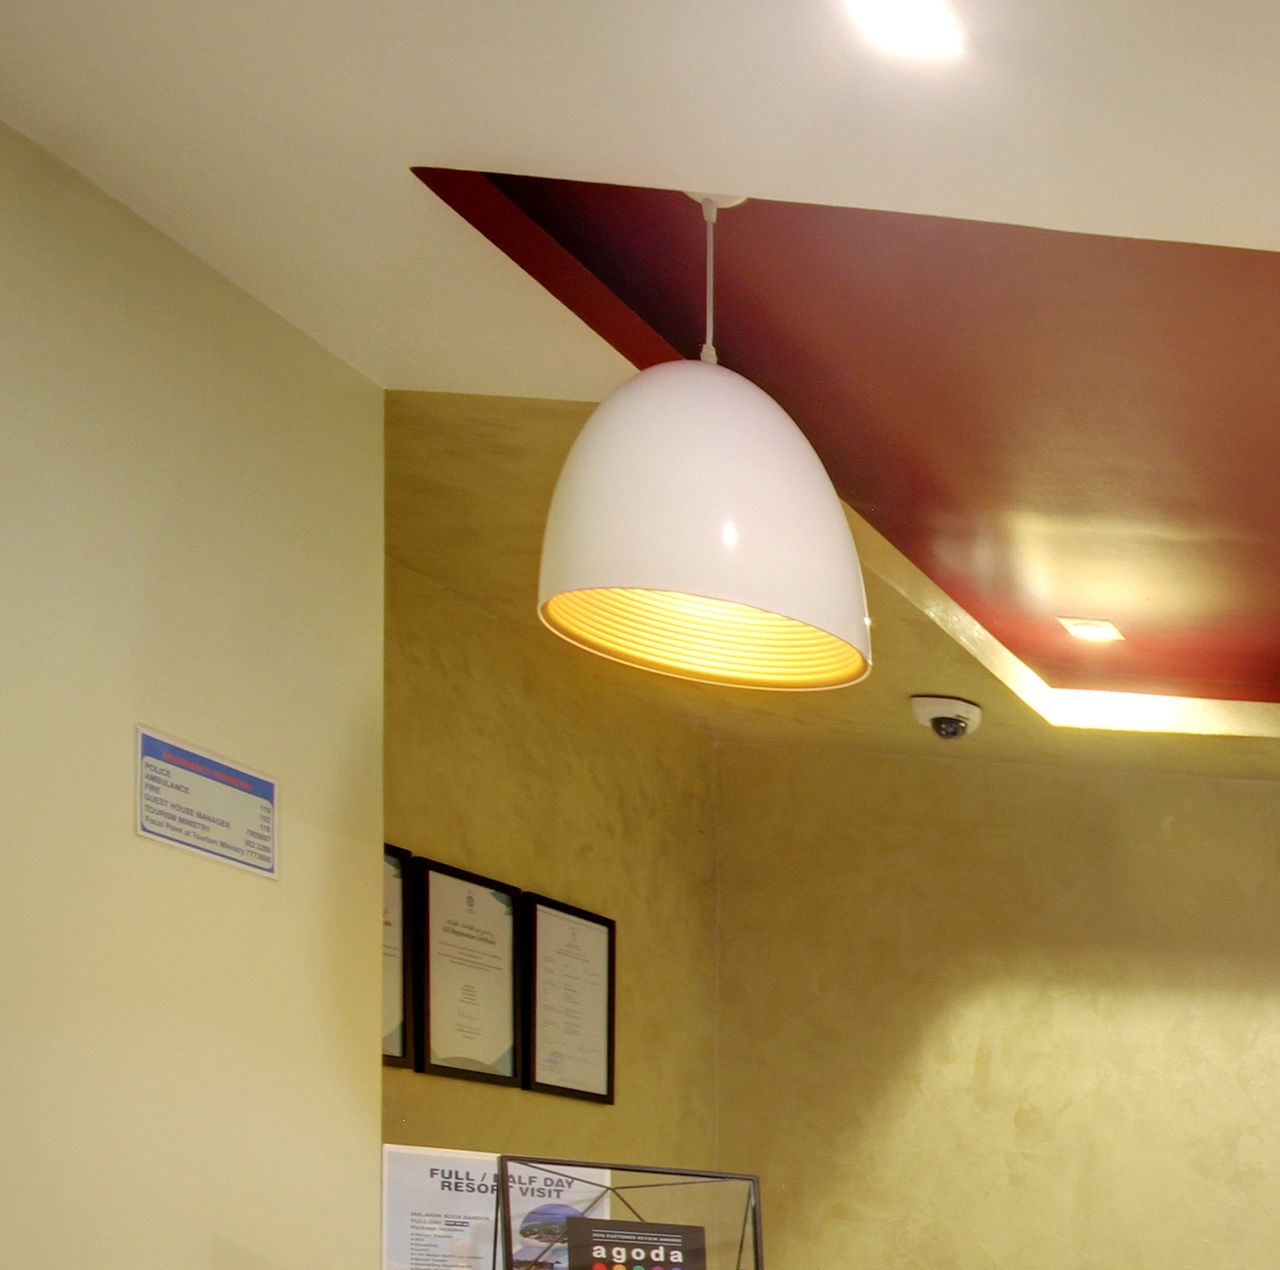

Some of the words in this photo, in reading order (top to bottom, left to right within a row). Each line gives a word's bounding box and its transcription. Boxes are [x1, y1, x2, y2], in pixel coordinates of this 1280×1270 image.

[144, 762, 171, 778] POLICE
[144, 774, 190, 795] AMBULANCE
[429, 1168, 475, 1182] FULL
[543, 1177, 575, 1189] DAY
[519, 1187, 564, 1199] VISIT
[592, 1244, 684, 1263] agoda
